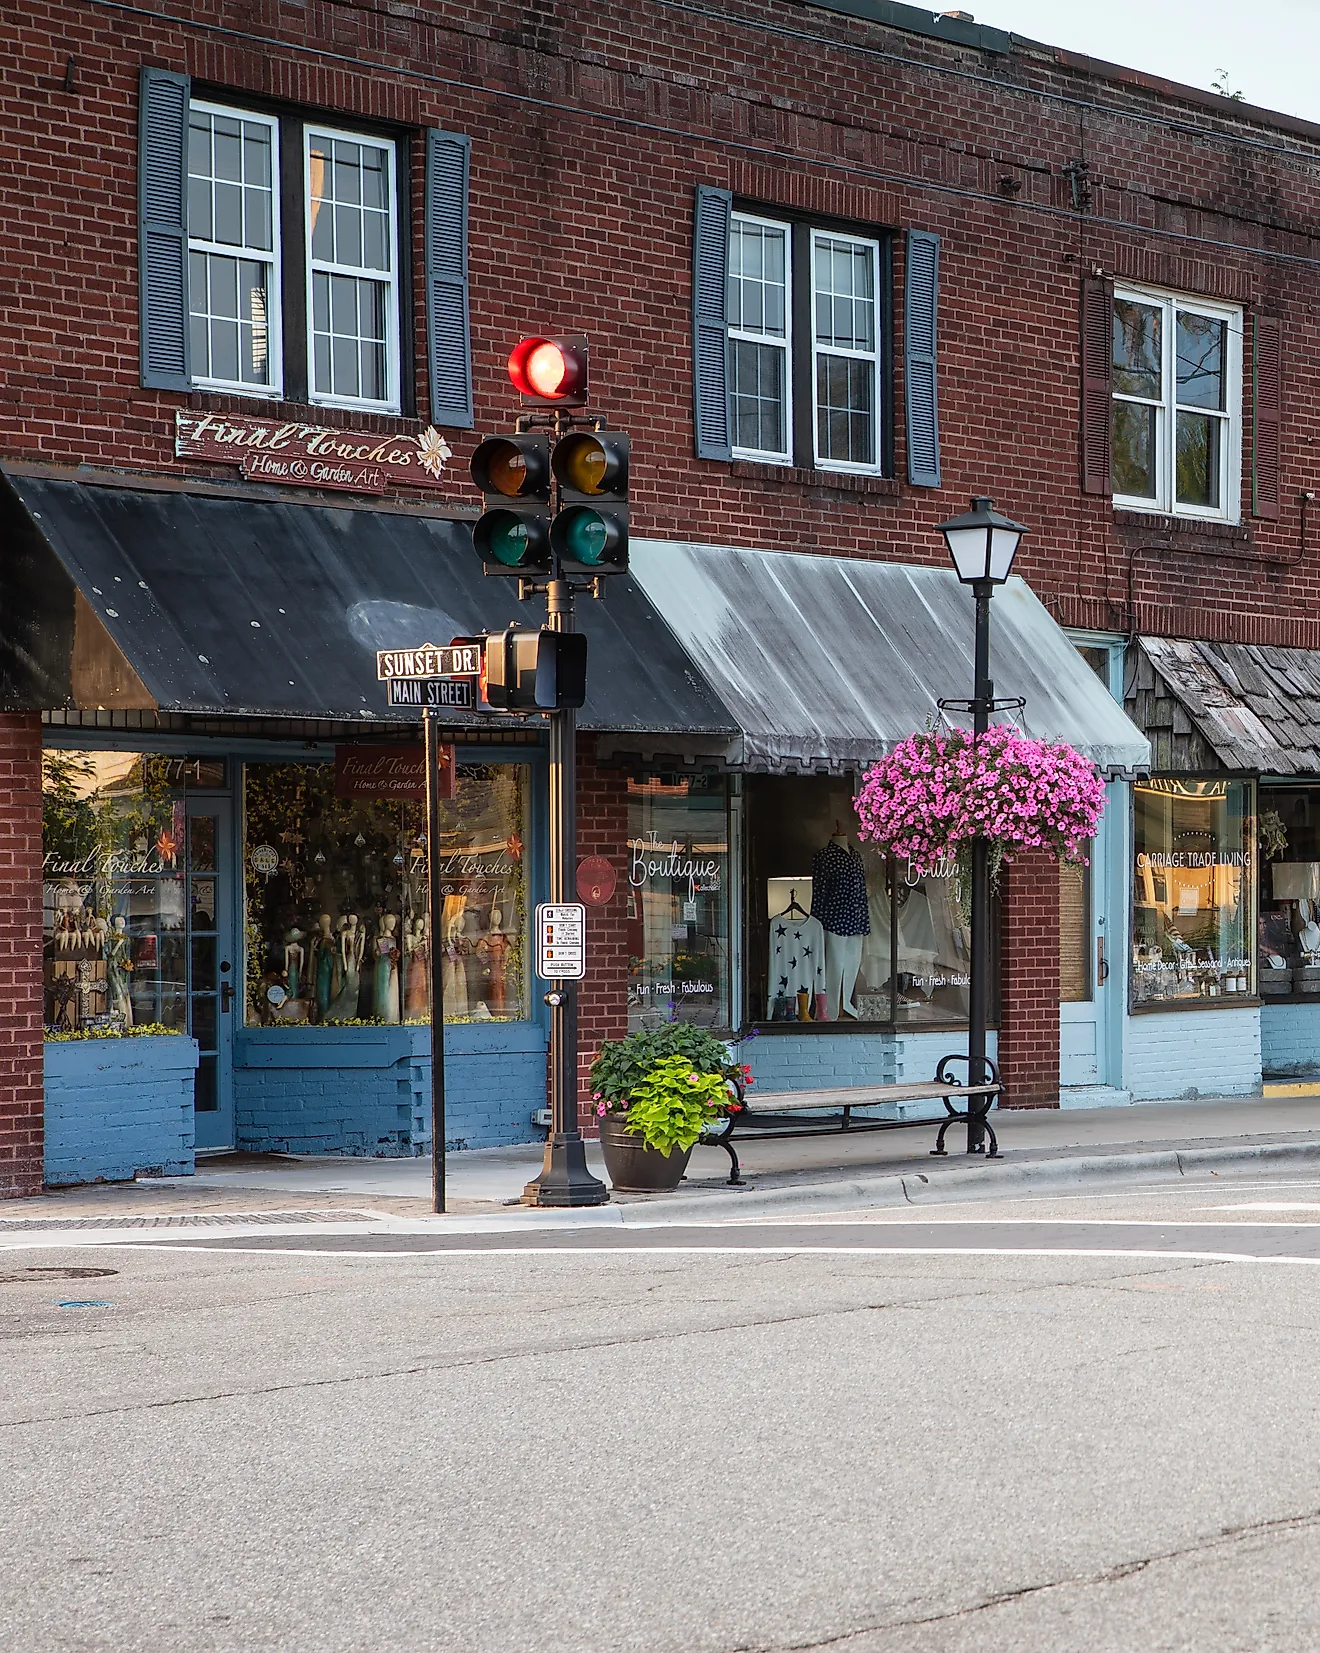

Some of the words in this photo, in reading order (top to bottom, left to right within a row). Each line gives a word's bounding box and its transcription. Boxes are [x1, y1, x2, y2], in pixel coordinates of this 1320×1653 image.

[192, 414, 299, 449] Final
[299, 430, 413, 466] Touches
[250, 454, 288, 476] Home
[310, 461, 353, 483] Garden
[354, 467, 379, 486] Art
[384, 651, 443, 676] SUNSET
[452, 649, 476, 672] DR.
[393, 681, 421, 704] MAIN
[427, 682, 468, 704] STREET
[342, 756, 384, 775] Final
[385, 757, 427, 775] Touch
[353, 779, 376, 789] Home
[388, 779, 417, 790] Garden
[646, 830, 665, 853] The
[42, 843, 101, 873] Final
[100, 845, 164, 874] Touches
[459, 848, 512, 875] Touches
[1137, 852, 1184, 867] CARRIAGE
[1187, 852, 1216, 867] TRADE
[1220, 851, 1251, 867] LIVING
[629, 838, 720, 904] Boutique
[46, 885, 74, 895] Home
[99, 881, 134, 898] Garden
[136, 884, 156, 895] Art
[459, 882, 487, 896] Garden
[488, 885, 505, 894] Art
[1137, 964, 1157, 973] Home
[1158, 962, 1175, 971] Decor
[1228, 955, 1251, 968] Antiques
[636, 983, 650, 995] Fun
[656, 981, 676, 994] Fresh
[681, 980, 714, 993] Fabulous
[912, 976, 924, 987] Fun
[928, 974, 946, 986] Fresh
